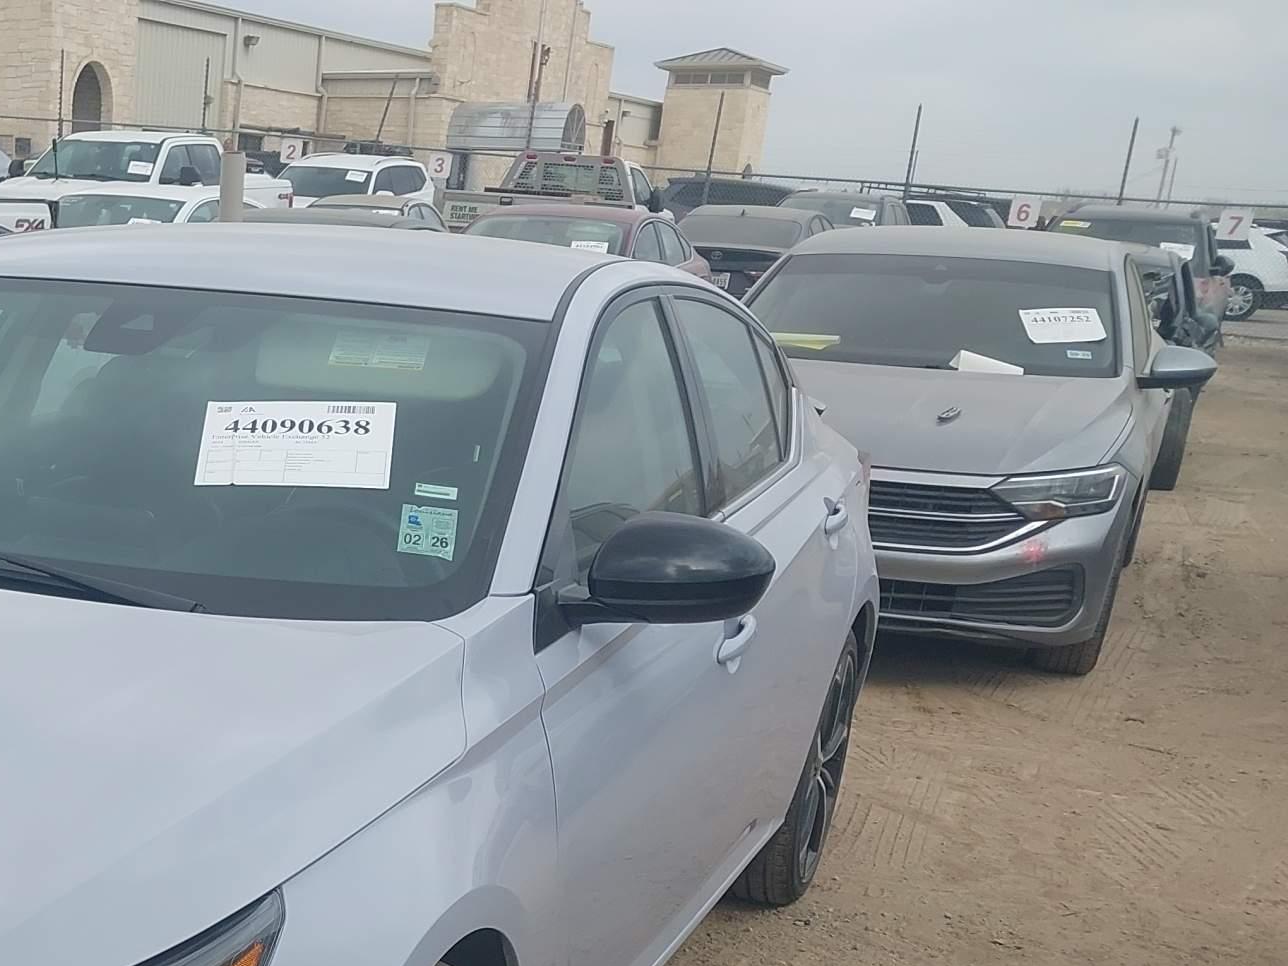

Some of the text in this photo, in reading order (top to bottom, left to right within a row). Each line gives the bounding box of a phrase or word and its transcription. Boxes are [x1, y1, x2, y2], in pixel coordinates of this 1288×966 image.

[285, 144, 296, 160] 2
[434, 157, 445, 174] 3
[1016, 203, 1031, 222] 6
[1227, 216, 1244, 236] 7
[1032, 315, 1092, 323] 44107252
[224, 418, 371, 436] 44090638
[404, 533, 422, 546] 02
[431, 536, 449, 549] 26
